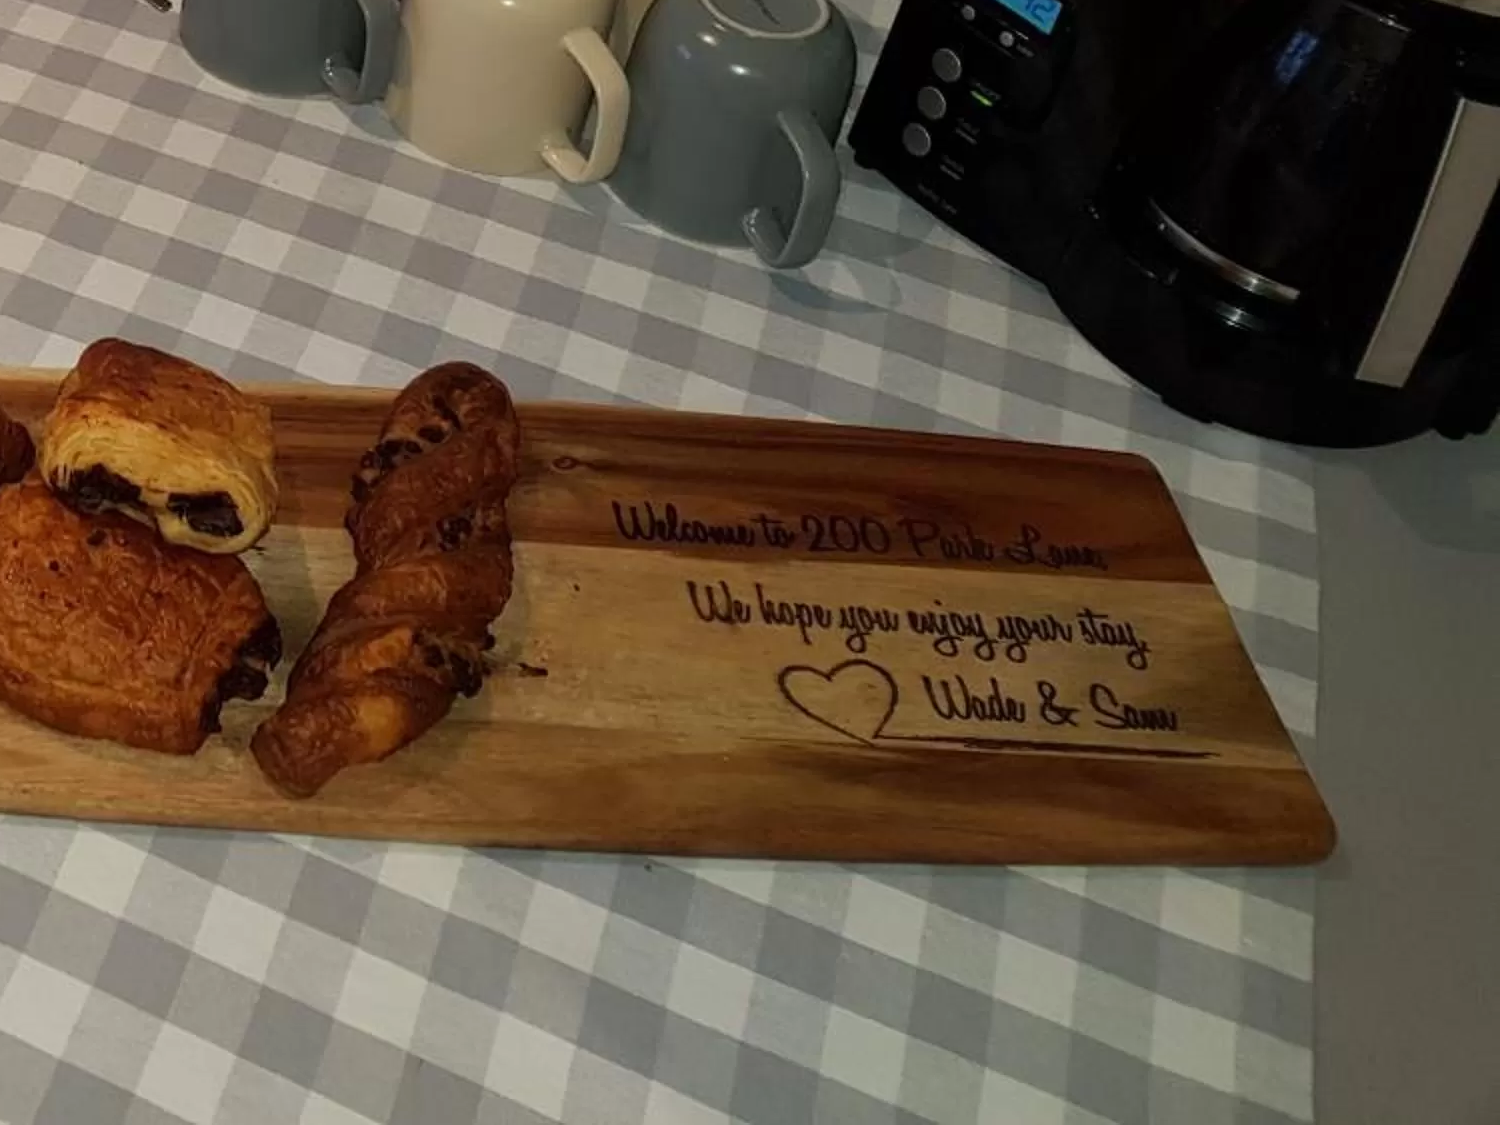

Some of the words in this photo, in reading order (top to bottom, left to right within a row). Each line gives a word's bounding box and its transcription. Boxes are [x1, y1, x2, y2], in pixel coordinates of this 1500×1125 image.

[612, 500, 754, 548] Welcome
[751, 514, 795, 548] to
[801, 514, 891, 554] 200
[896, 518, 994, 561] Park
[687, 580, 751, 625] We
[754, 582, 831, 646] hope
[839, 606, 899, 653] you
[907, 599, 996, 661] enjoy
[996, 614, 1072, 663] your
[1076, 607, 1151, 670] stay
[921, 674, 1026, 723] Wade
[1036, 680, 1080, 727] &
